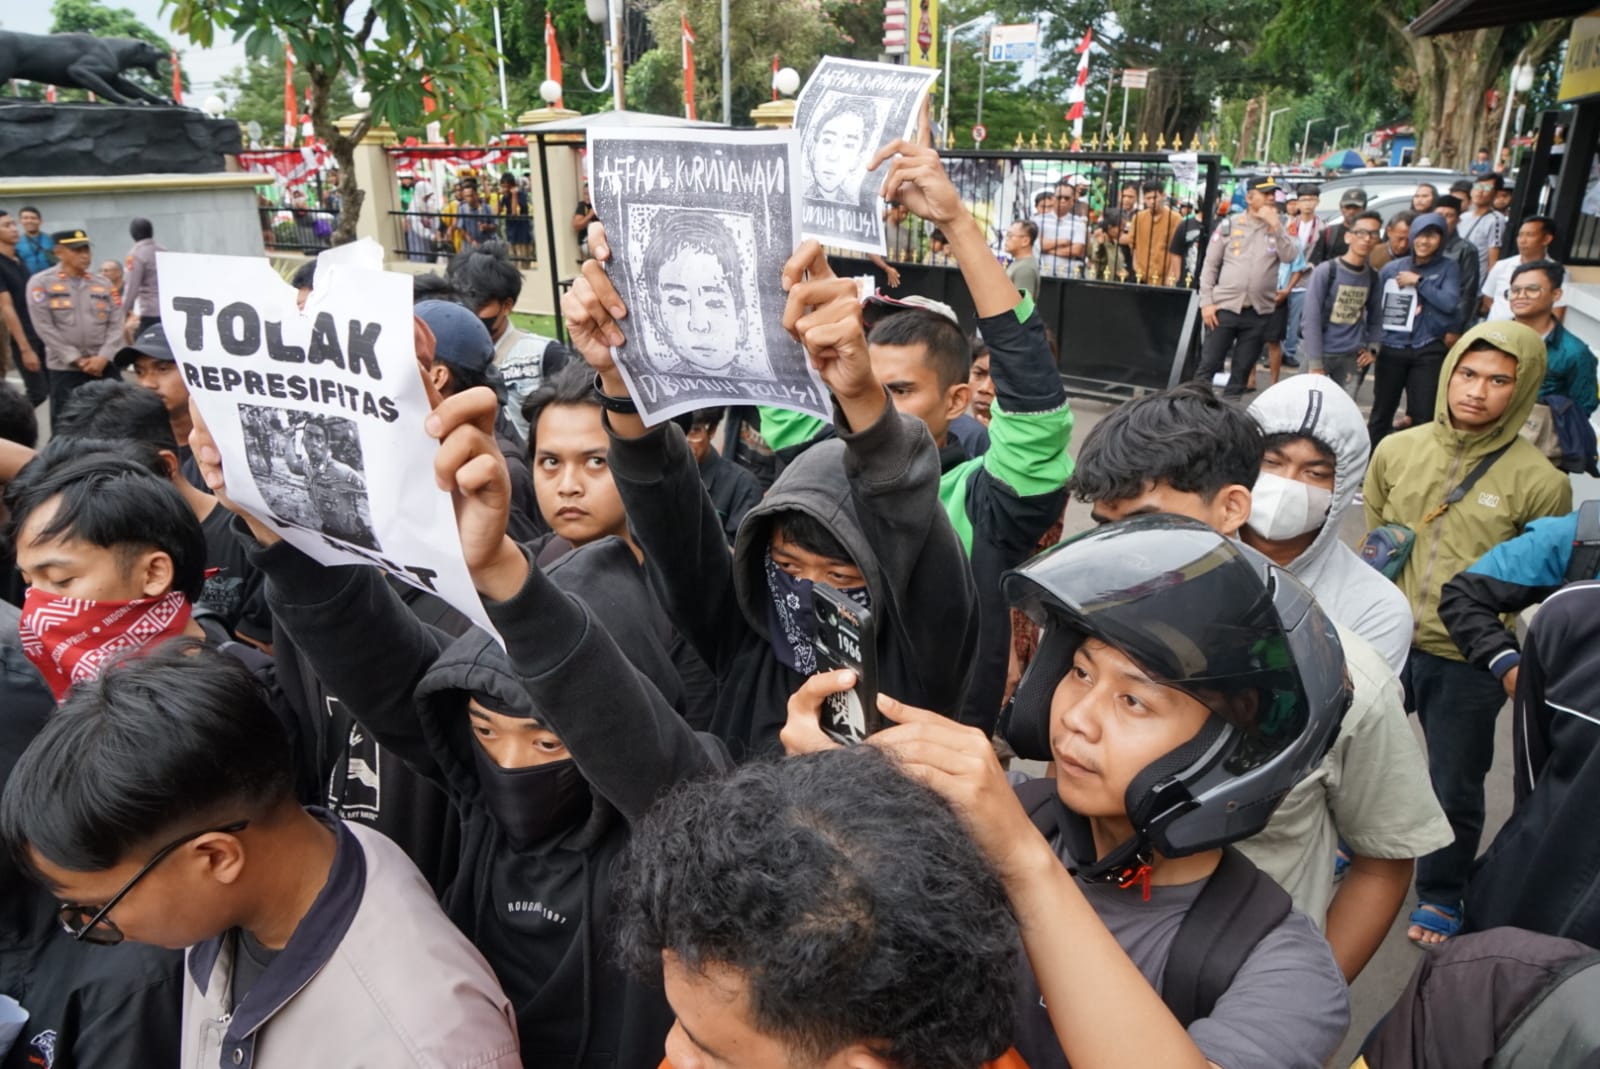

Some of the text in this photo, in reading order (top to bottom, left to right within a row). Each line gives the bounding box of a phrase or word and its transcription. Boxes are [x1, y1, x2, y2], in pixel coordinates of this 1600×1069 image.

[837, 209, 877, 238] POLISI
[172, 296, 383, 380] TOLAK
[183, 362, 400, 423] REPRESIFITAS
[639, 375, 818, 406] DIBUNUH POLISI
[838, 633, 862, 663] 1966
